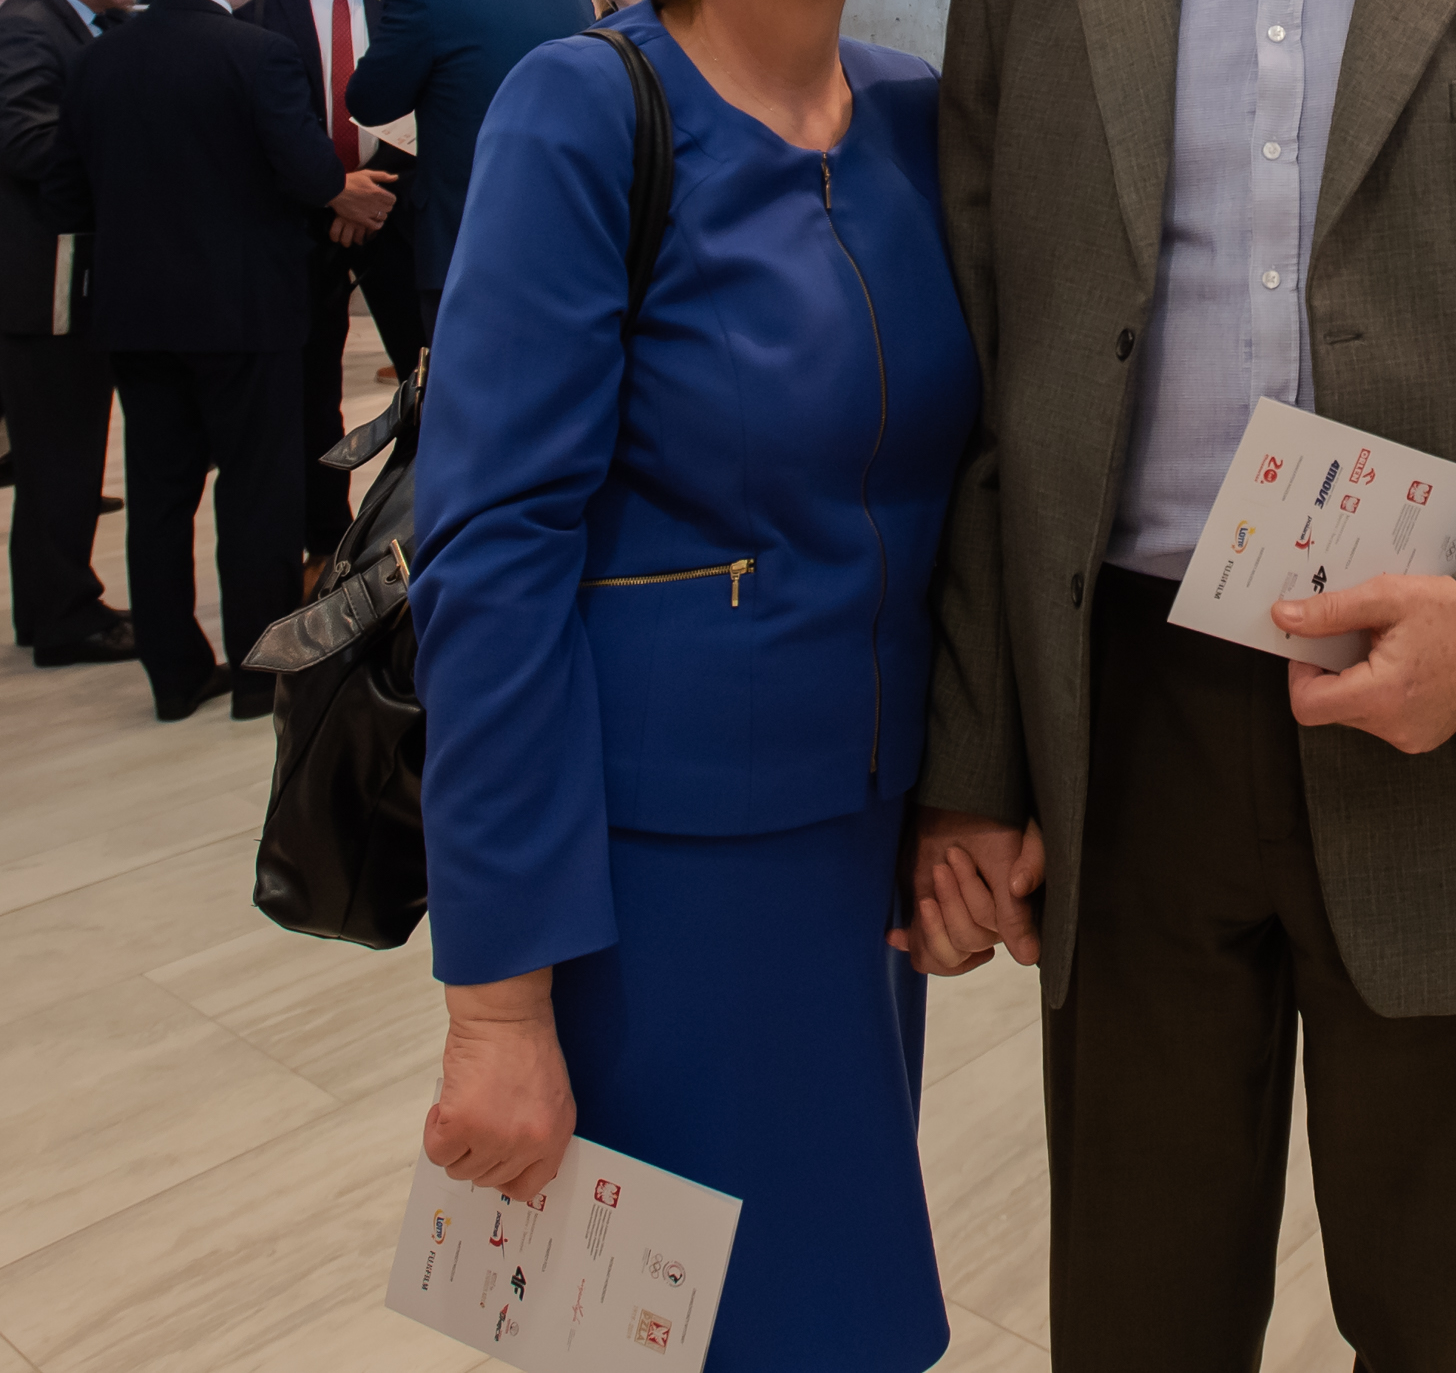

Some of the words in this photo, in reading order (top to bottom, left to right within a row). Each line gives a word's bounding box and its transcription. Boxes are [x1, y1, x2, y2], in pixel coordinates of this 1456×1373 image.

[1350, 451, 1369, 483] ORLEN
[1214, 560, 1234, 600] FUJIFILM
[1310, 565, 1328, 595] 4F
[421, 1250, 437, 1291] FUJIFILM
[510, 1265, 528, 1302] 4F
